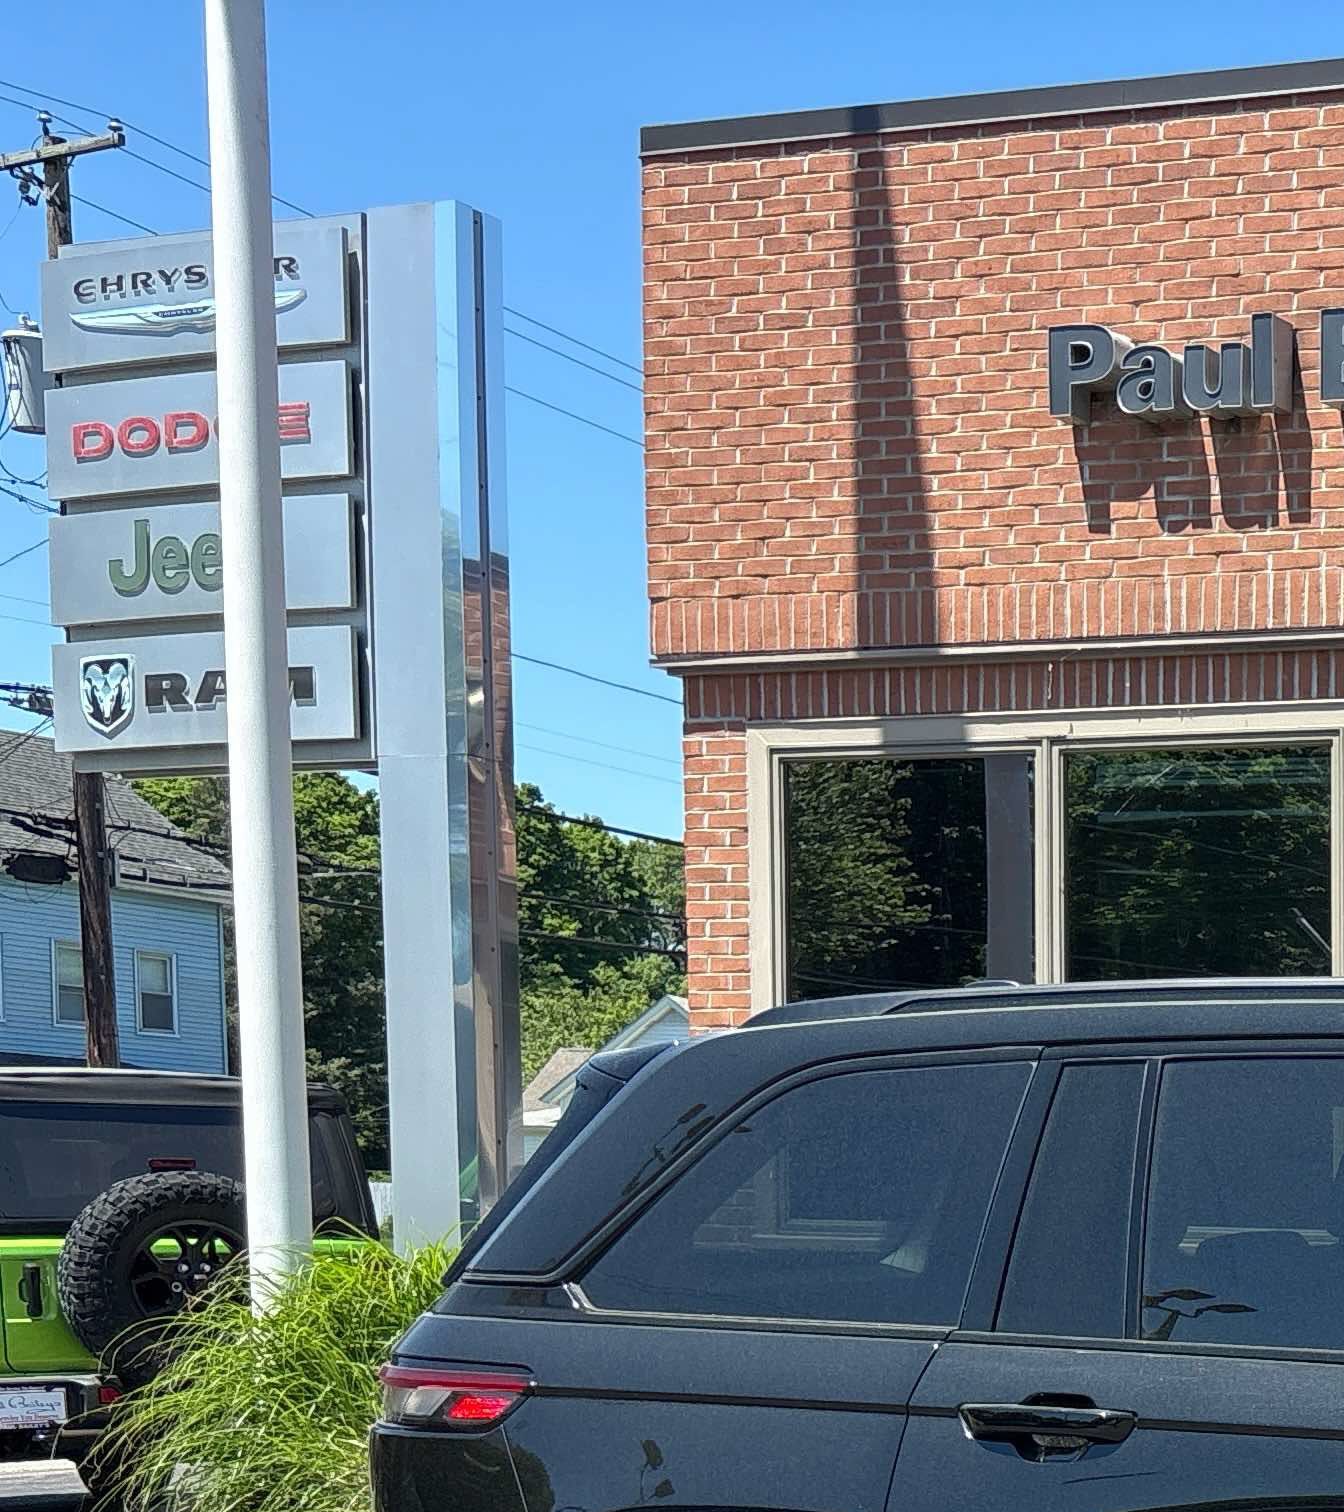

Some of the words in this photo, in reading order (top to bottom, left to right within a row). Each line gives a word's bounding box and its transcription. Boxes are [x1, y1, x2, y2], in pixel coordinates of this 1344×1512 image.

[73, 255, 298, 303] CHRYSR
[1047, 312, 1291, 423] Paul
[72, 401, 310, 463] DODE
[108, 519, 224, 597] Jee
